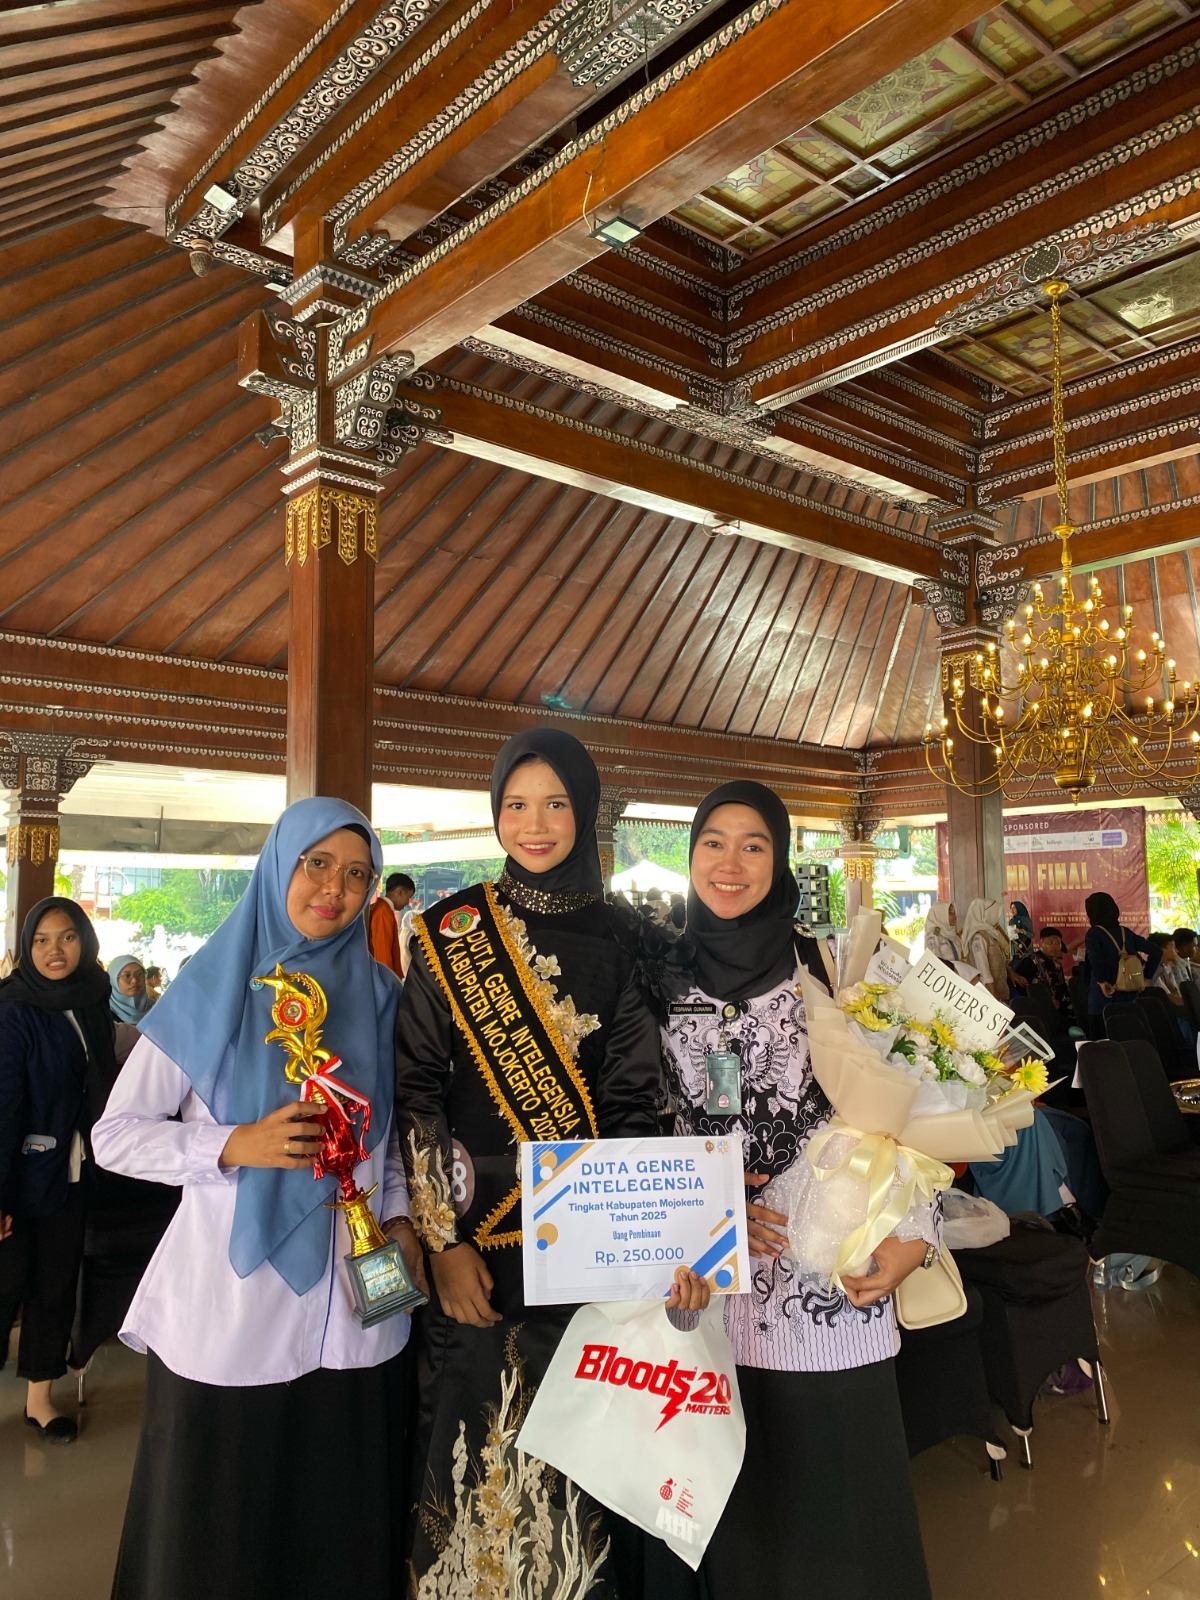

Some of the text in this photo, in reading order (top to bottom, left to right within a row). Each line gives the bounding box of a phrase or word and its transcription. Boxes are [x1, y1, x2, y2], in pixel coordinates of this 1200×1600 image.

[1004, 822, 1049, 832] SPONSORED
[1037, 861, 1093, 891] FINAL
[917, 962, 989, 1023] FLOWERS
[444, 938, 489, 1022] KABUPATEN
[480, 1019, 542, 1112] MOJOKERTO
[466, 930, 582, 1135] DUTA GENRE INTELEGENSIA
[581, 1159, 696, 1176] DUTA GENRE
[573, 1177, 705, 1195] INTELEGENSIA
[568, 1198, 705, 1214] Tingkat Kabupaten Mojokerto
[609, 1211, 667, 1222] Tahun 2025
[612, 1229, 662, 1241] Uang Pembinaan
[595, 1247, 684, 1267] Rp. 250.000
[574, 1344, 732, 1405] Bloods 20
[684, 1402, 732, 1416] MATTERS
